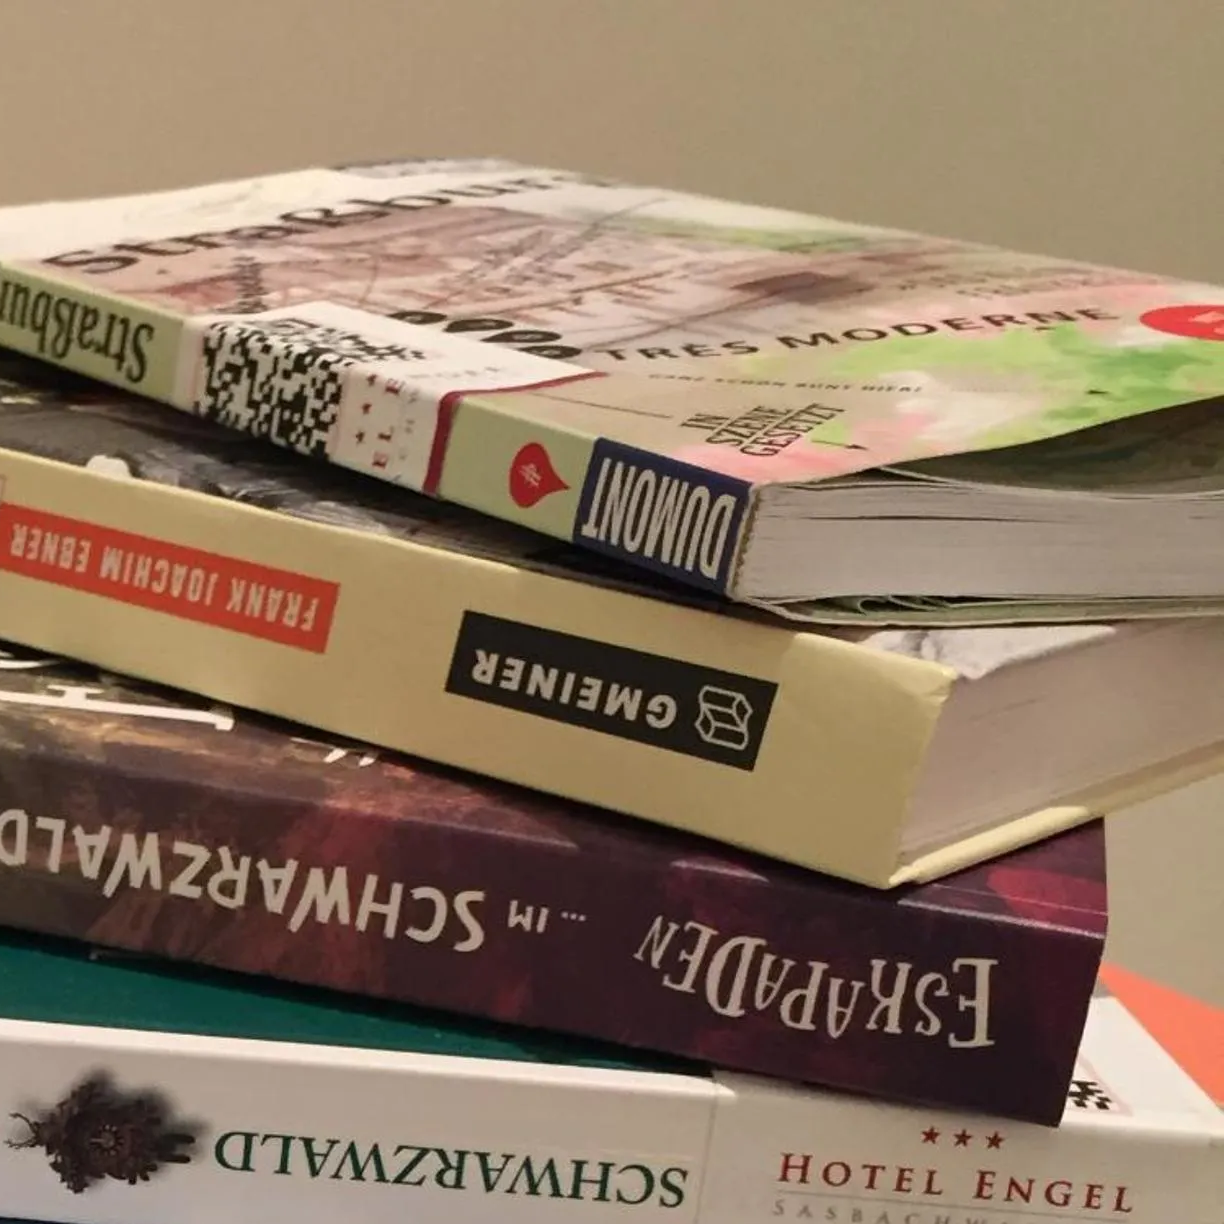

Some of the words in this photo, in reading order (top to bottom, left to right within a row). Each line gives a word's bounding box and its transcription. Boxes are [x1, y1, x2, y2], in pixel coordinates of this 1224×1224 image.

[592, 339, 760, 364] TRÈS
[775, 307, 1120, 351] MODERNE
[680, 413, 730, 431] IN
[706, 404, 794, 447] SZENE
[740, 403, 846, 457] GESETZT
[582, 456, 736, 581] DUMONT
[9, 522, 92, 573] EBNER
[99, 542, 219, 607] JOACHIM
[227, 576, 319, 633] FRANK
[472, 648, 678, 730] GMEINER
[216, 1128, 687, 1209] SCHWARZWALD
[778, 1152, 944, 1196] HOTEL
[973, 1170, 1134, 1213] ENGEL
